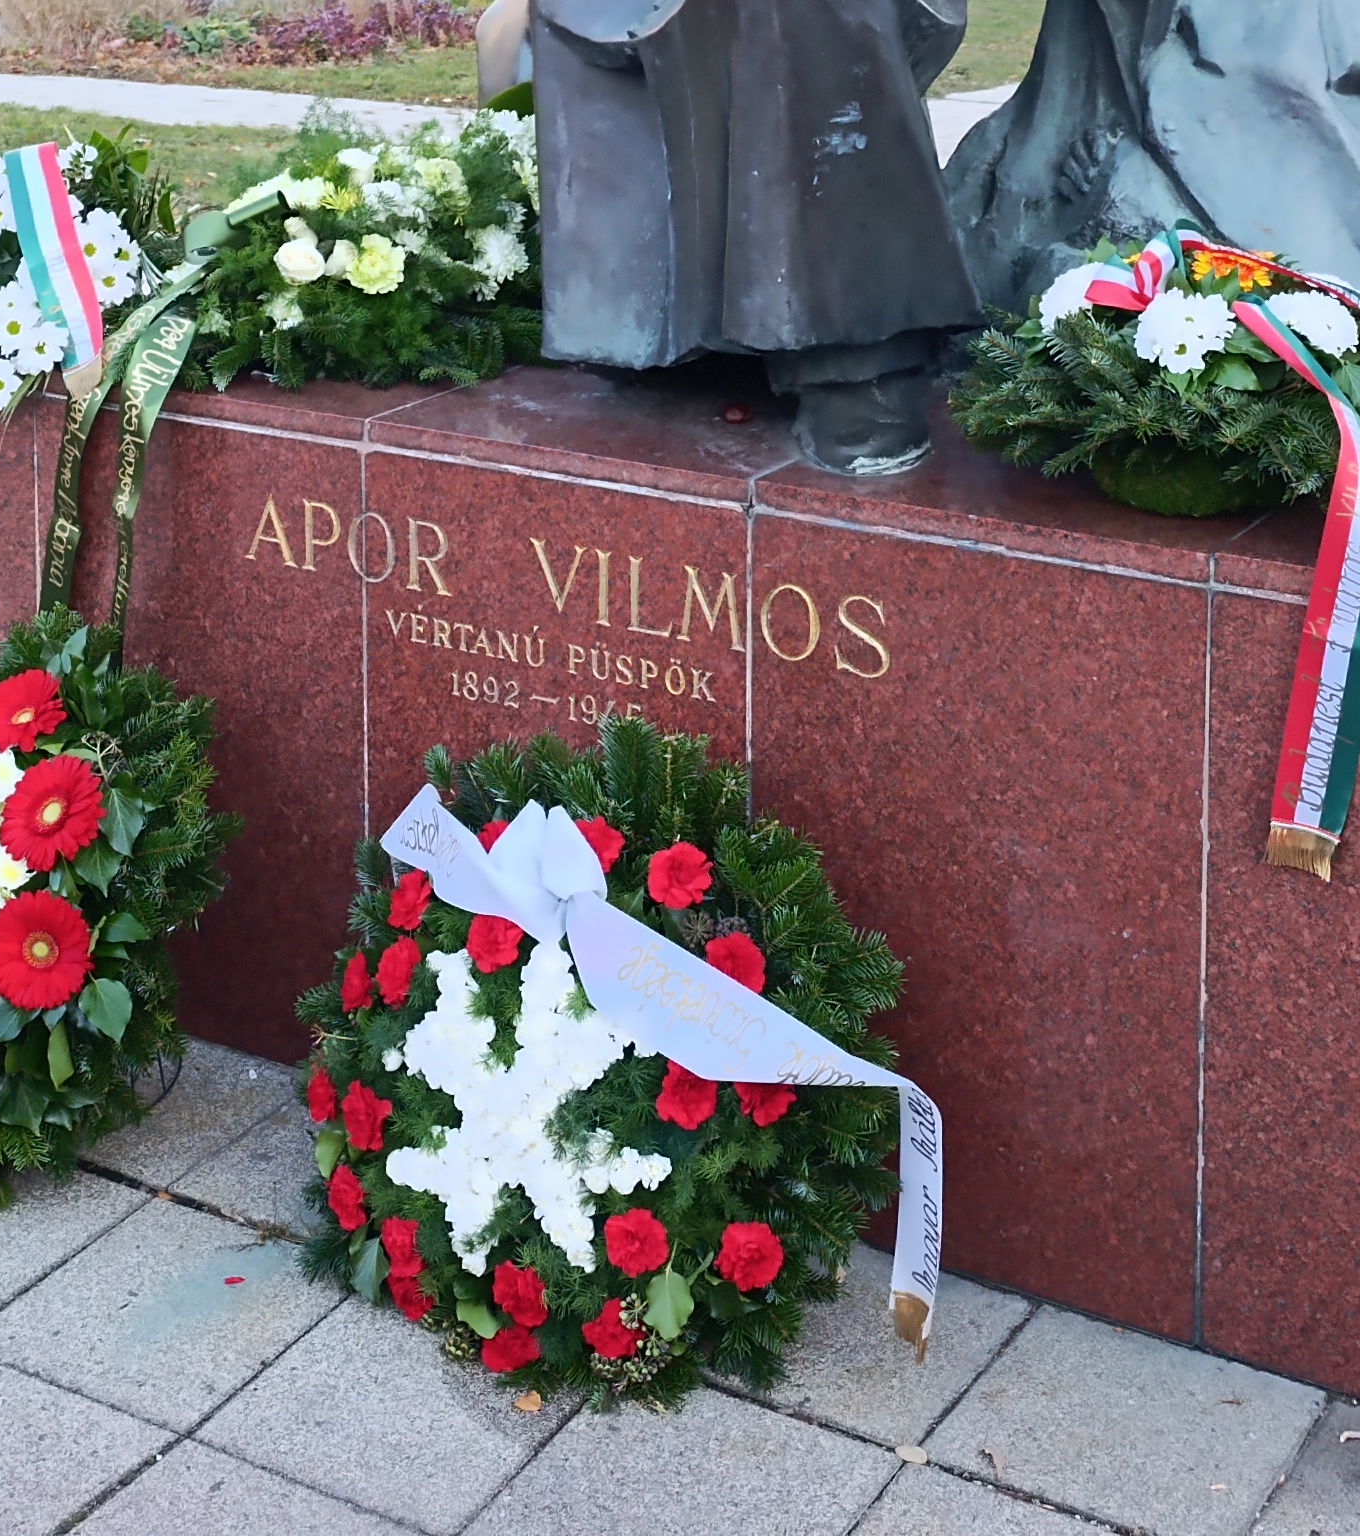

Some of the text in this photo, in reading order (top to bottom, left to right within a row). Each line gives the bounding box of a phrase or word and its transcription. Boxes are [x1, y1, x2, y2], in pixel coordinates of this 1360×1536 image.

[245, 493, 890, 678] APOR VILMOS
[385, 604, 717, 703] VÉRTANÚ PÜSPÖK
[451, 669, 520, 709] 1892
